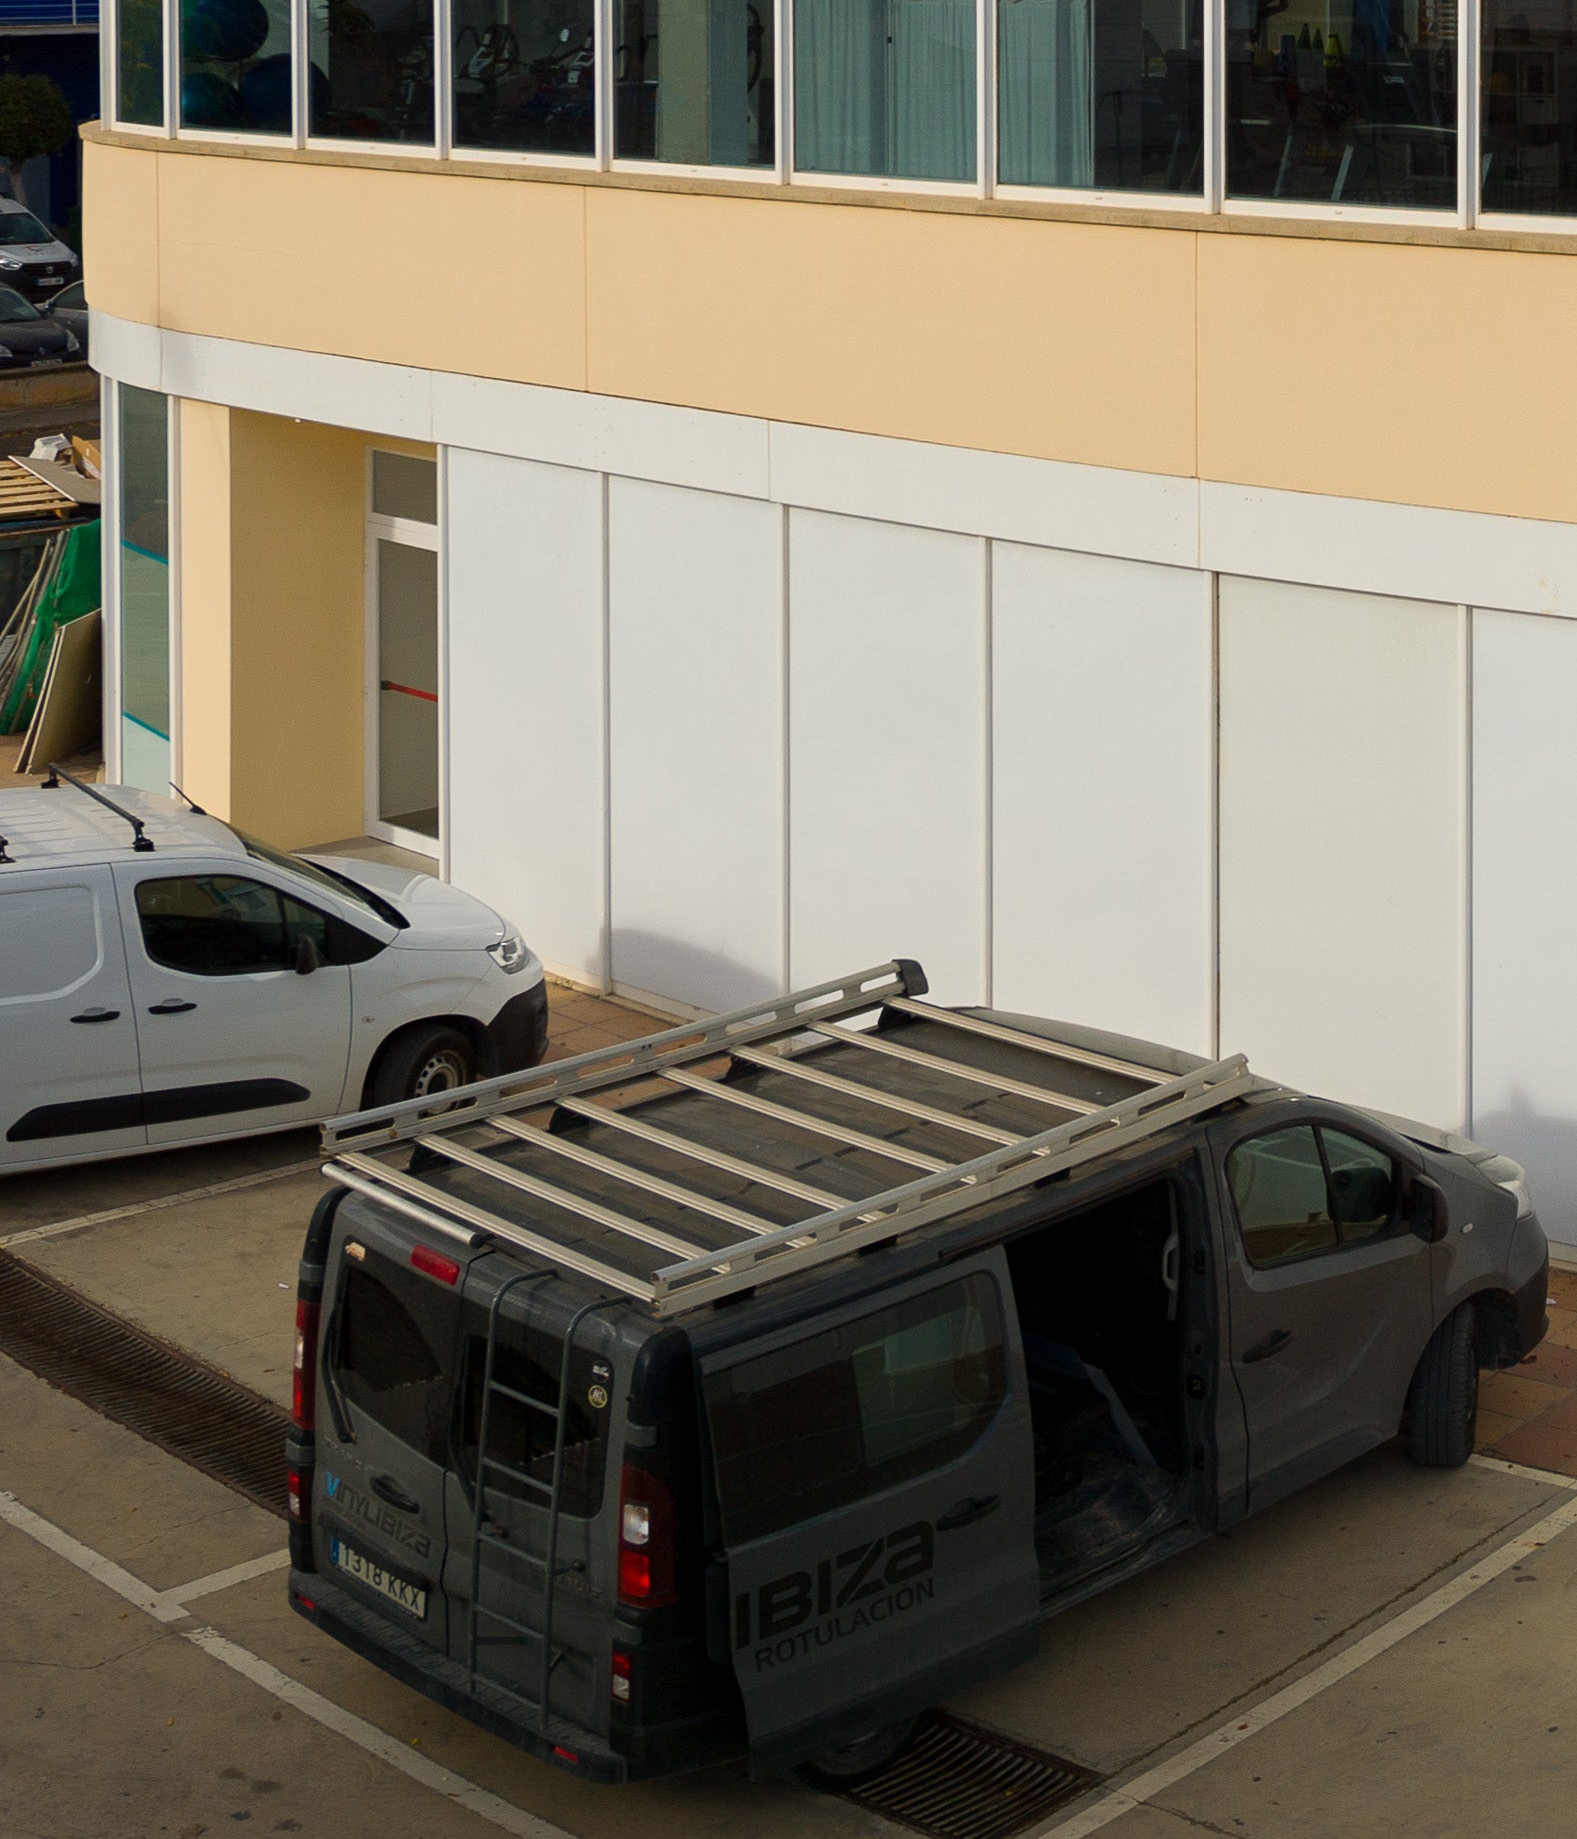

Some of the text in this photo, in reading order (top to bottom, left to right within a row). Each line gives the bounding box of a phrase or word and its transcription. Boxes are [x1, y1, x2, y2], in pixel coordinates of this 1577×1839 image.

[344, 1544, 420, 1612] 1318 KKX
[755, 1577, 935, 1673] ROTULACIÓN
